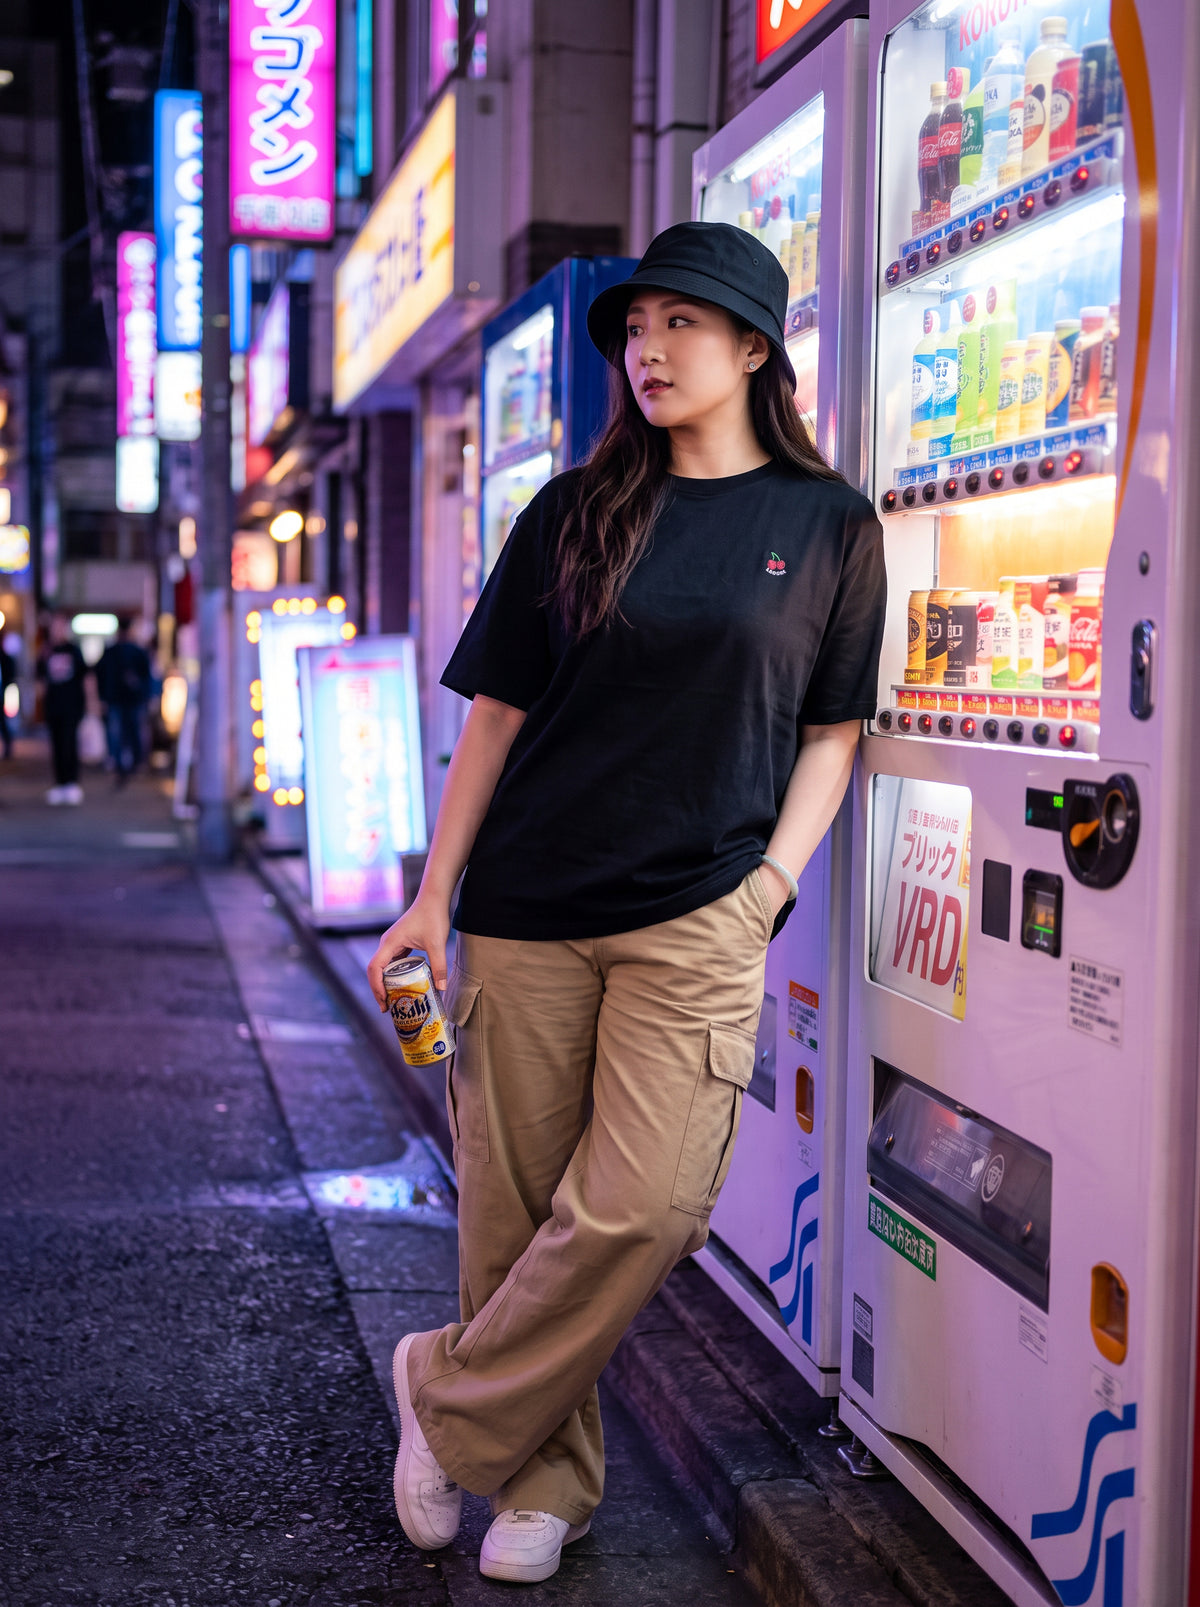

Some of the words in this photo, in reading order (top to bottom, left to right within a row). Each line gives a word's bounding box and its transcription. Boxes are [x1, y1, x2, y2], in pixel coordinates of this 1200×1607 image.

[902, 831, 957, 881] ブリック
[893, 881, 962, 986] VRD
[391, 994, 431, 1020] Asahi
